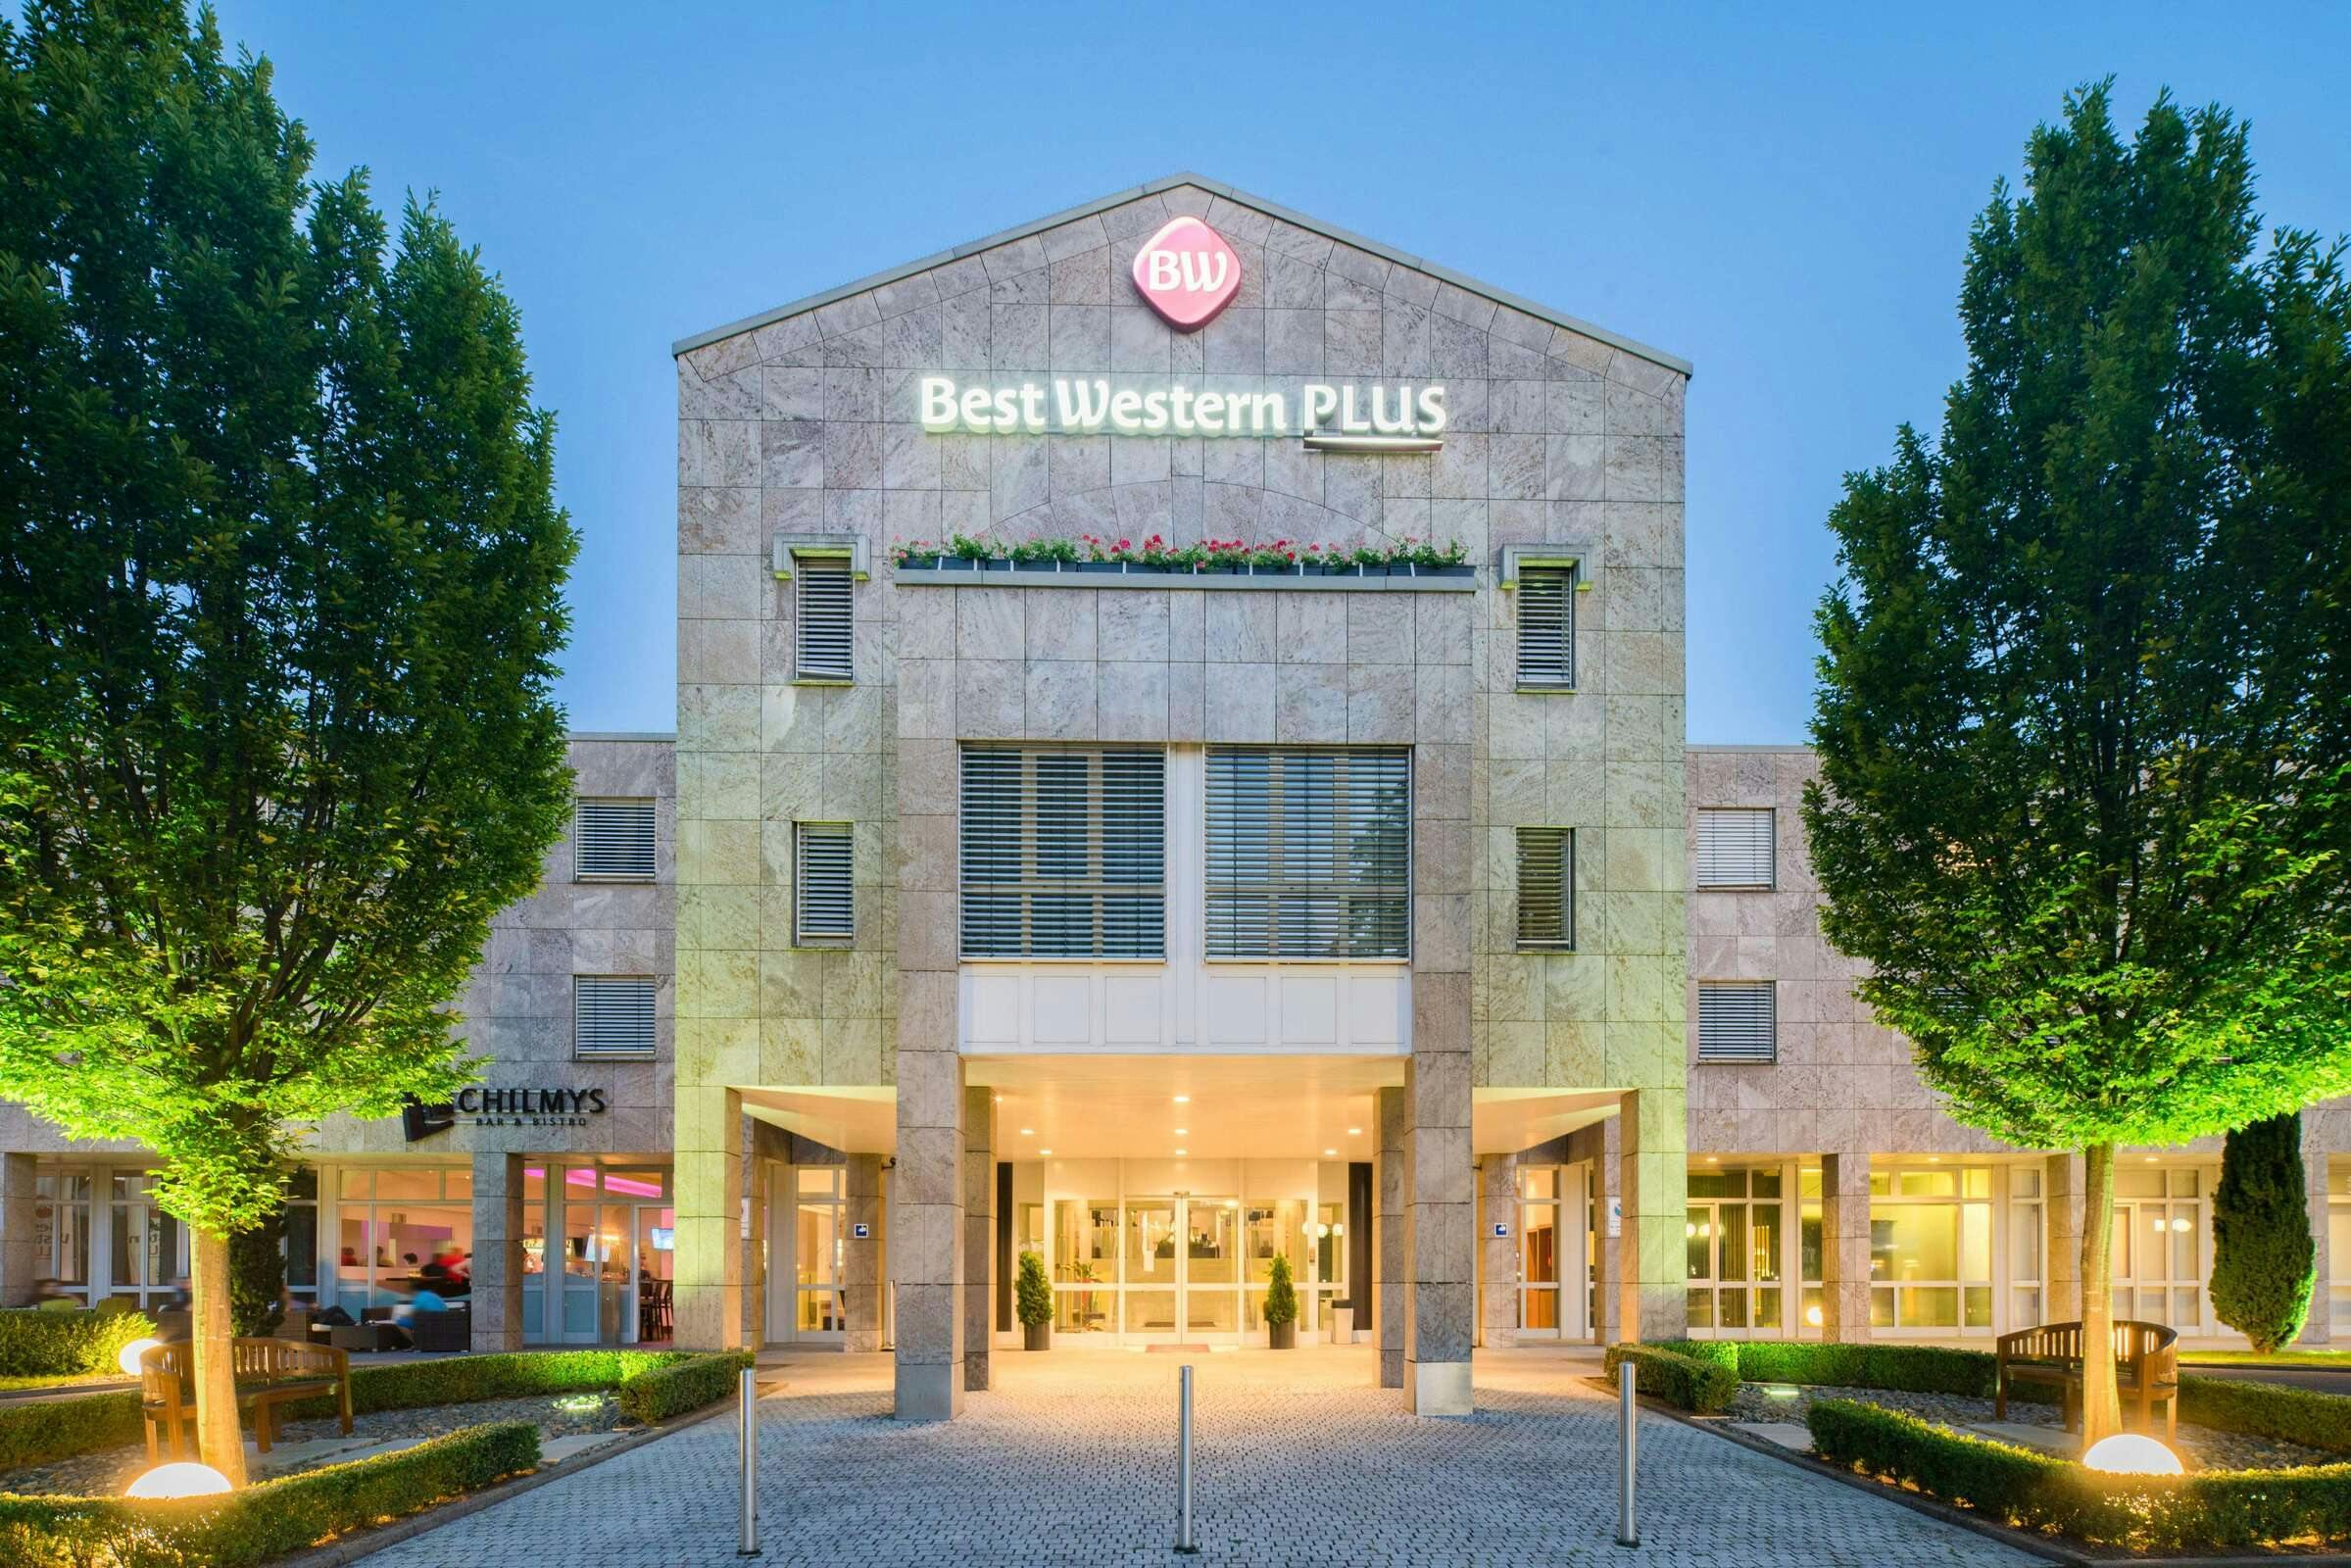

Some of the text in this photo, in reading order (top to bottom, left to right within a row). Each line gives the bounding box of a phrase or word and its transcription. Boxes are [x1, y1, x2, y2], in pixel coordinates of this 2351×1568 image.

[1149, 250, 1228, 292] BW
[921, 377, 1446, 435] Best Western PLUS
[458, 1088, 607, 1114] CHILMYS
[476, 1116, 587, 1127] BAR & BISTRO
